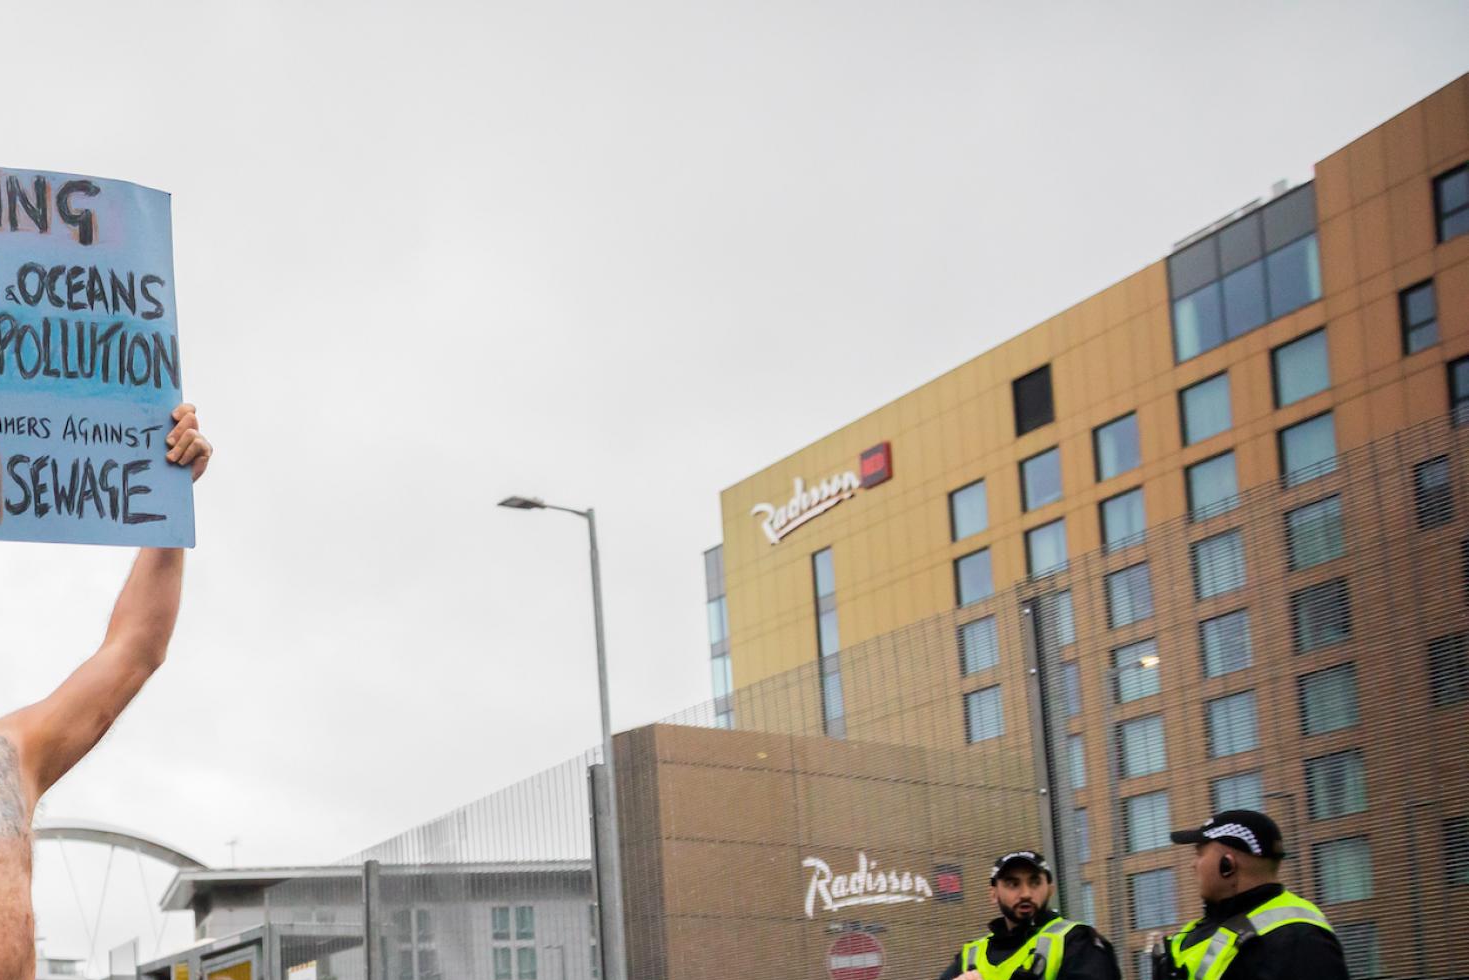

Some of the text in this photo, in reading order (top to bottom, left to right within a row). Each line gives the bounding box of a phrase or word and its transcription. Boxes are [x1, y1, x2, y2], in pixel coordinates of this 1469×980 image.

[63, 417, 164, 448] AGAINST
[5, 455, 168, 524] SEWAGE
[801, 850, 933, 919] Radisson
